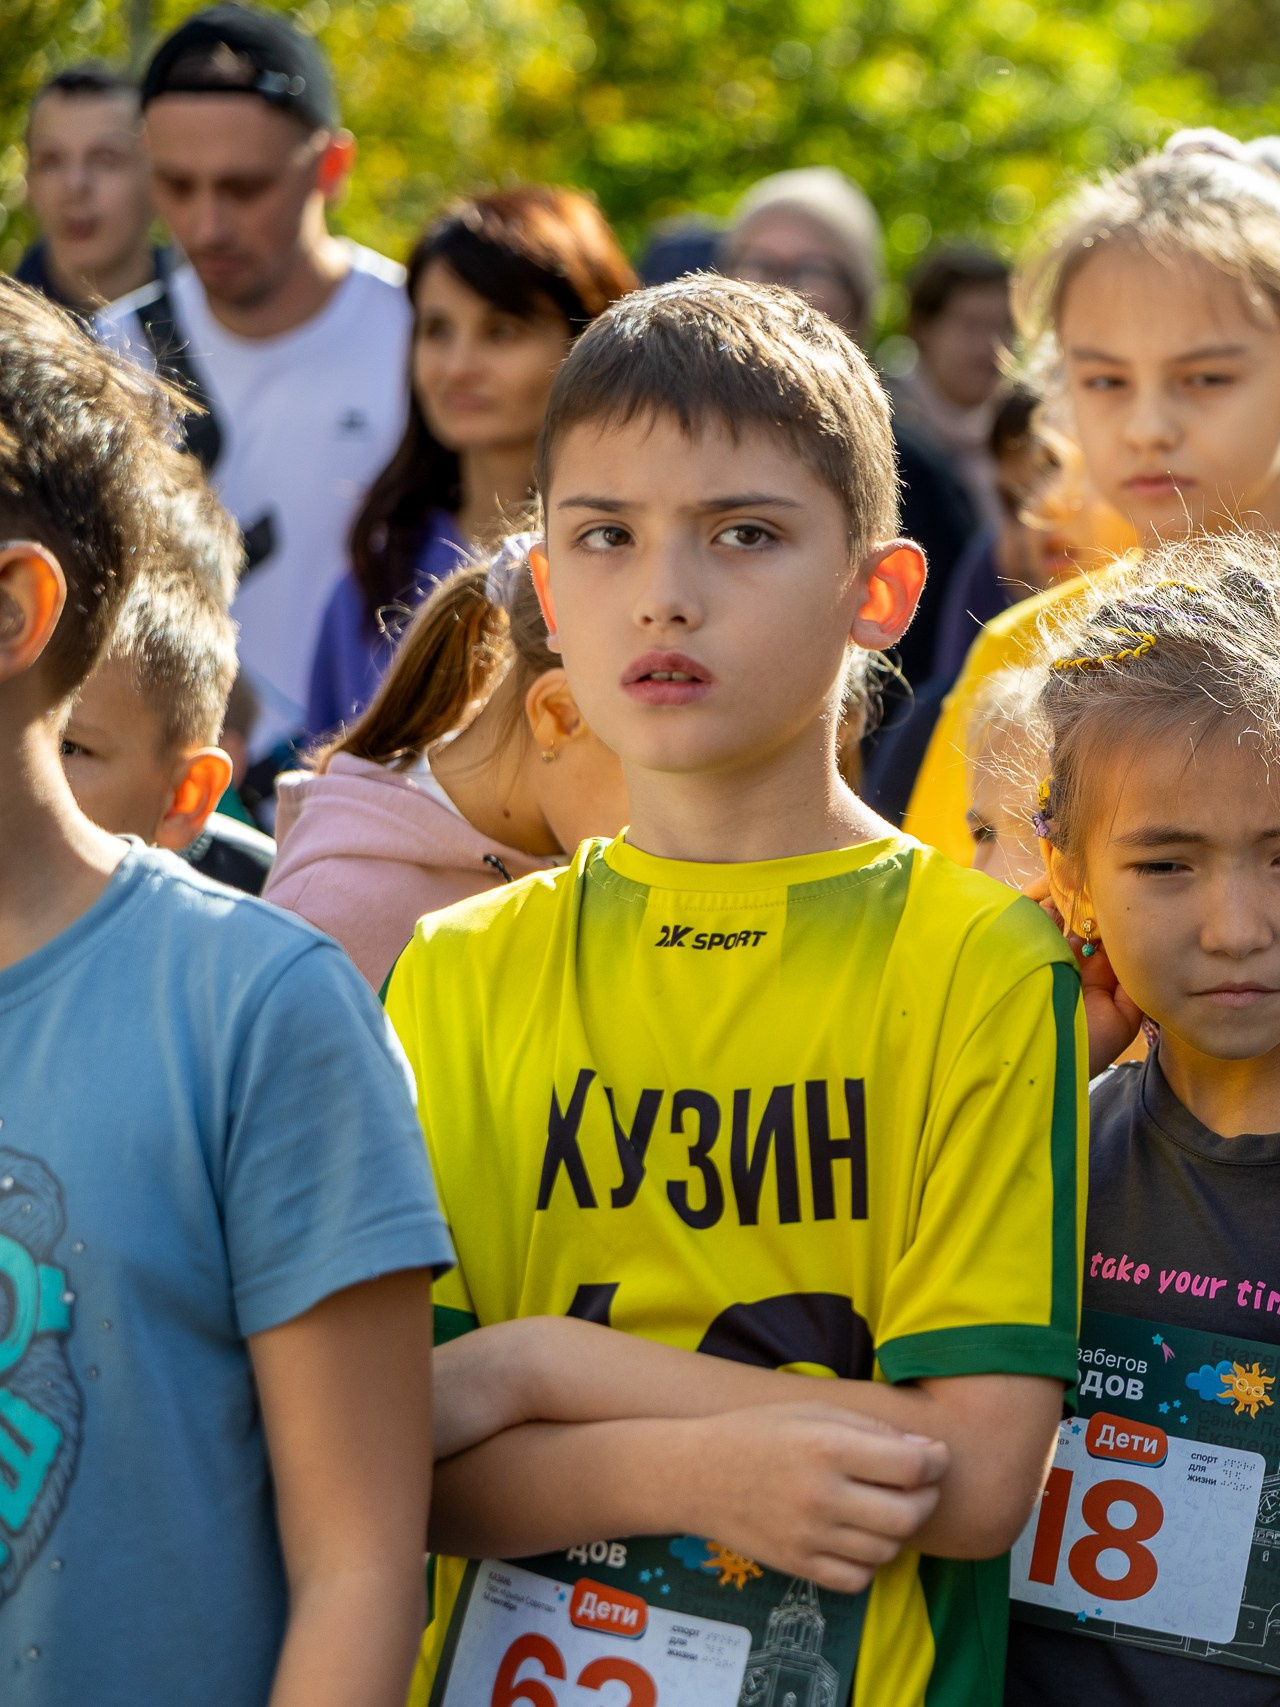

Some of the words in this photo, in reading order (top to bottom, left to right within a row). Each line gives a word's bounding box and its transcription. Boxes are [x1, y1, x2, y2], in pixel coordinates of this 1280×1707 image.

[691, 930, 768, 951] SPORT
[535, 1068, 869, 1229] КУЗИН
[1090, 1251, 1150, 1285] take
[1158, 1269, 1228, 1300] your
[1095, 1424, 1158, 1454] Дети
[1188, 1463, 1207, 1473] для
[1191, 1453, 1218, 1464] спорт
[1186, 1474, 1217, 1486] жизни
[1028, 1466, 1164, 1601] 18
[577, 1591, 639, 1627] Дети
